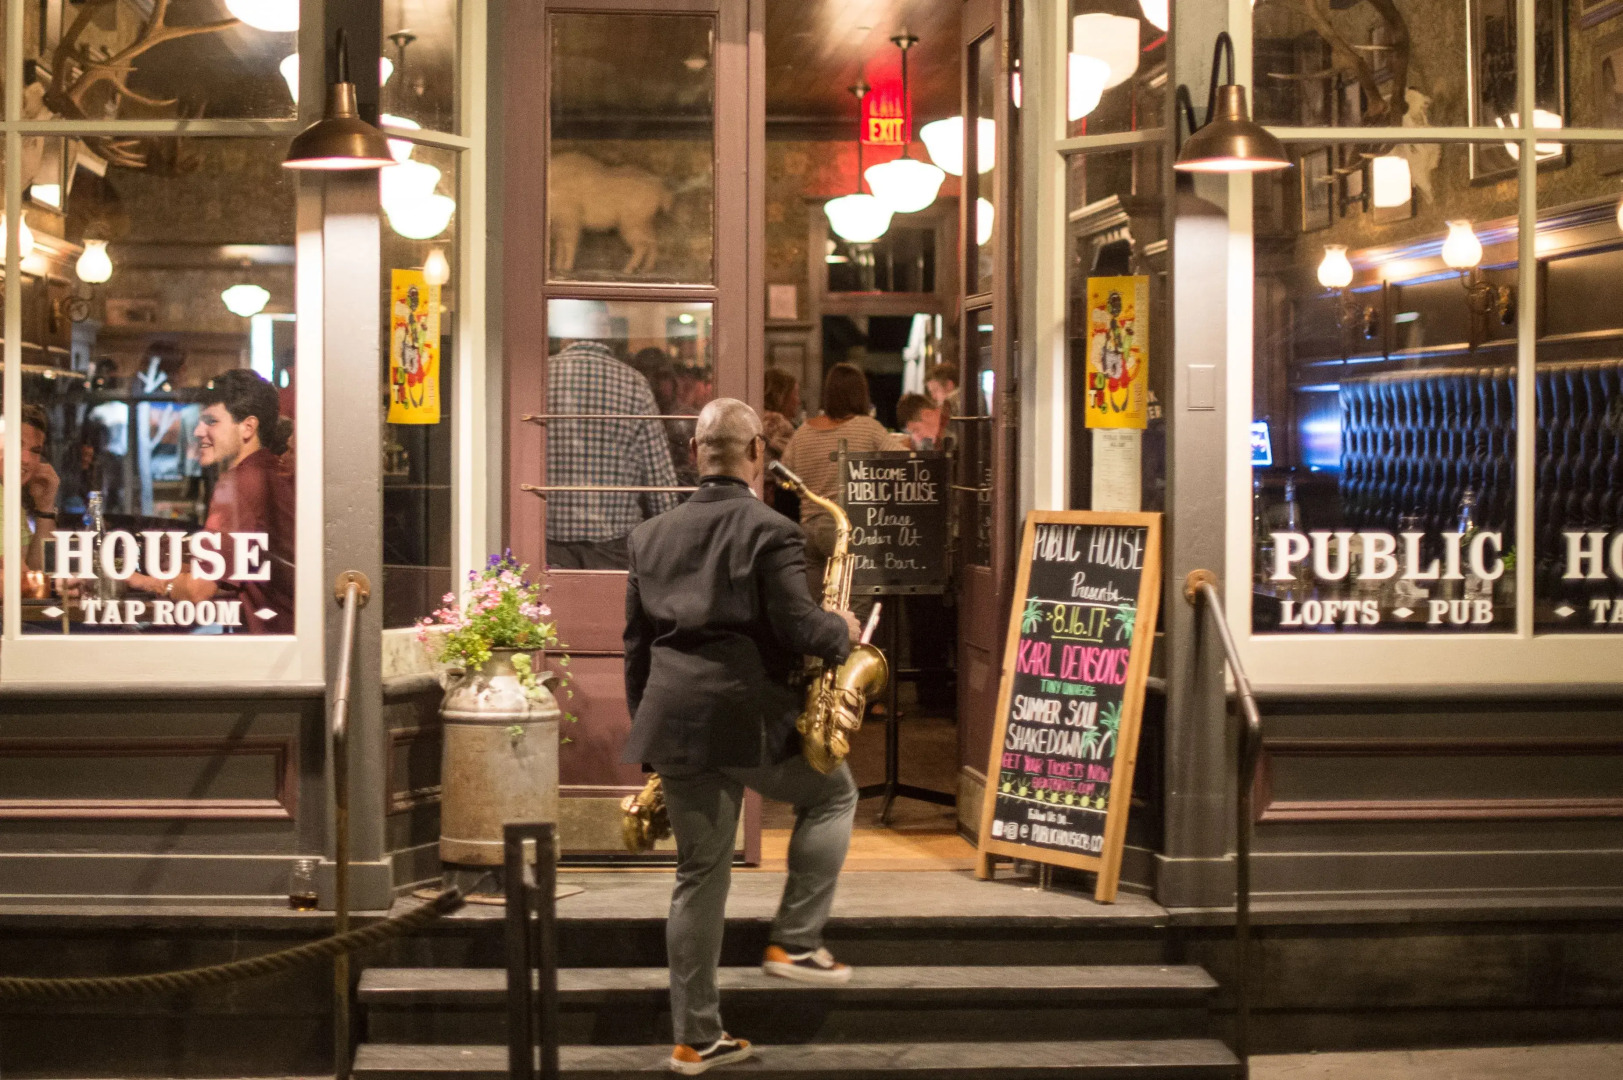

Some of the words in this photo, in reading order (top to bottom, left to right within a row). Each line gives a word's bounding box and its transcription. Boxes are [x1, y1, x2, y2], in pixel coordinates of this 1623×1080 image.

[869, 118, 904, 144] EXIT
[848, 482, 891, 501] PUBLIC
[894, 482, 938, 502] HOUSE
[866, 508, 914, 526] Please
[851, 527, 892, 546] Order
[899, 527, 922, 546] At
[1033, 525, 1081, 562] PUBLIC
[1088, 526, 1147, 570] HOUSE
[50, 530, 271, 581] HOUSE
[884, 552, 926, 570] Bar.
[1270, 531, 1504, 581] PUBLIC
[81, 599, 146, 626] TAP
[152, 600, 243, 626] ROOM
[1052, 604, 1106, 638] 8.16.17
[1279, 599, 1381, 626] LOFTS
[1428, 599, 1494, 625] PUB
[1016, 639, 1055, 677] KARL
[1012, 695, 1061, 725] SUMMER
[1065, 699, 1099, 730] SOUL
[1005, 723, 1083, 759] SHAKEDOWN
[1001, 752, 1021, 769] GET
